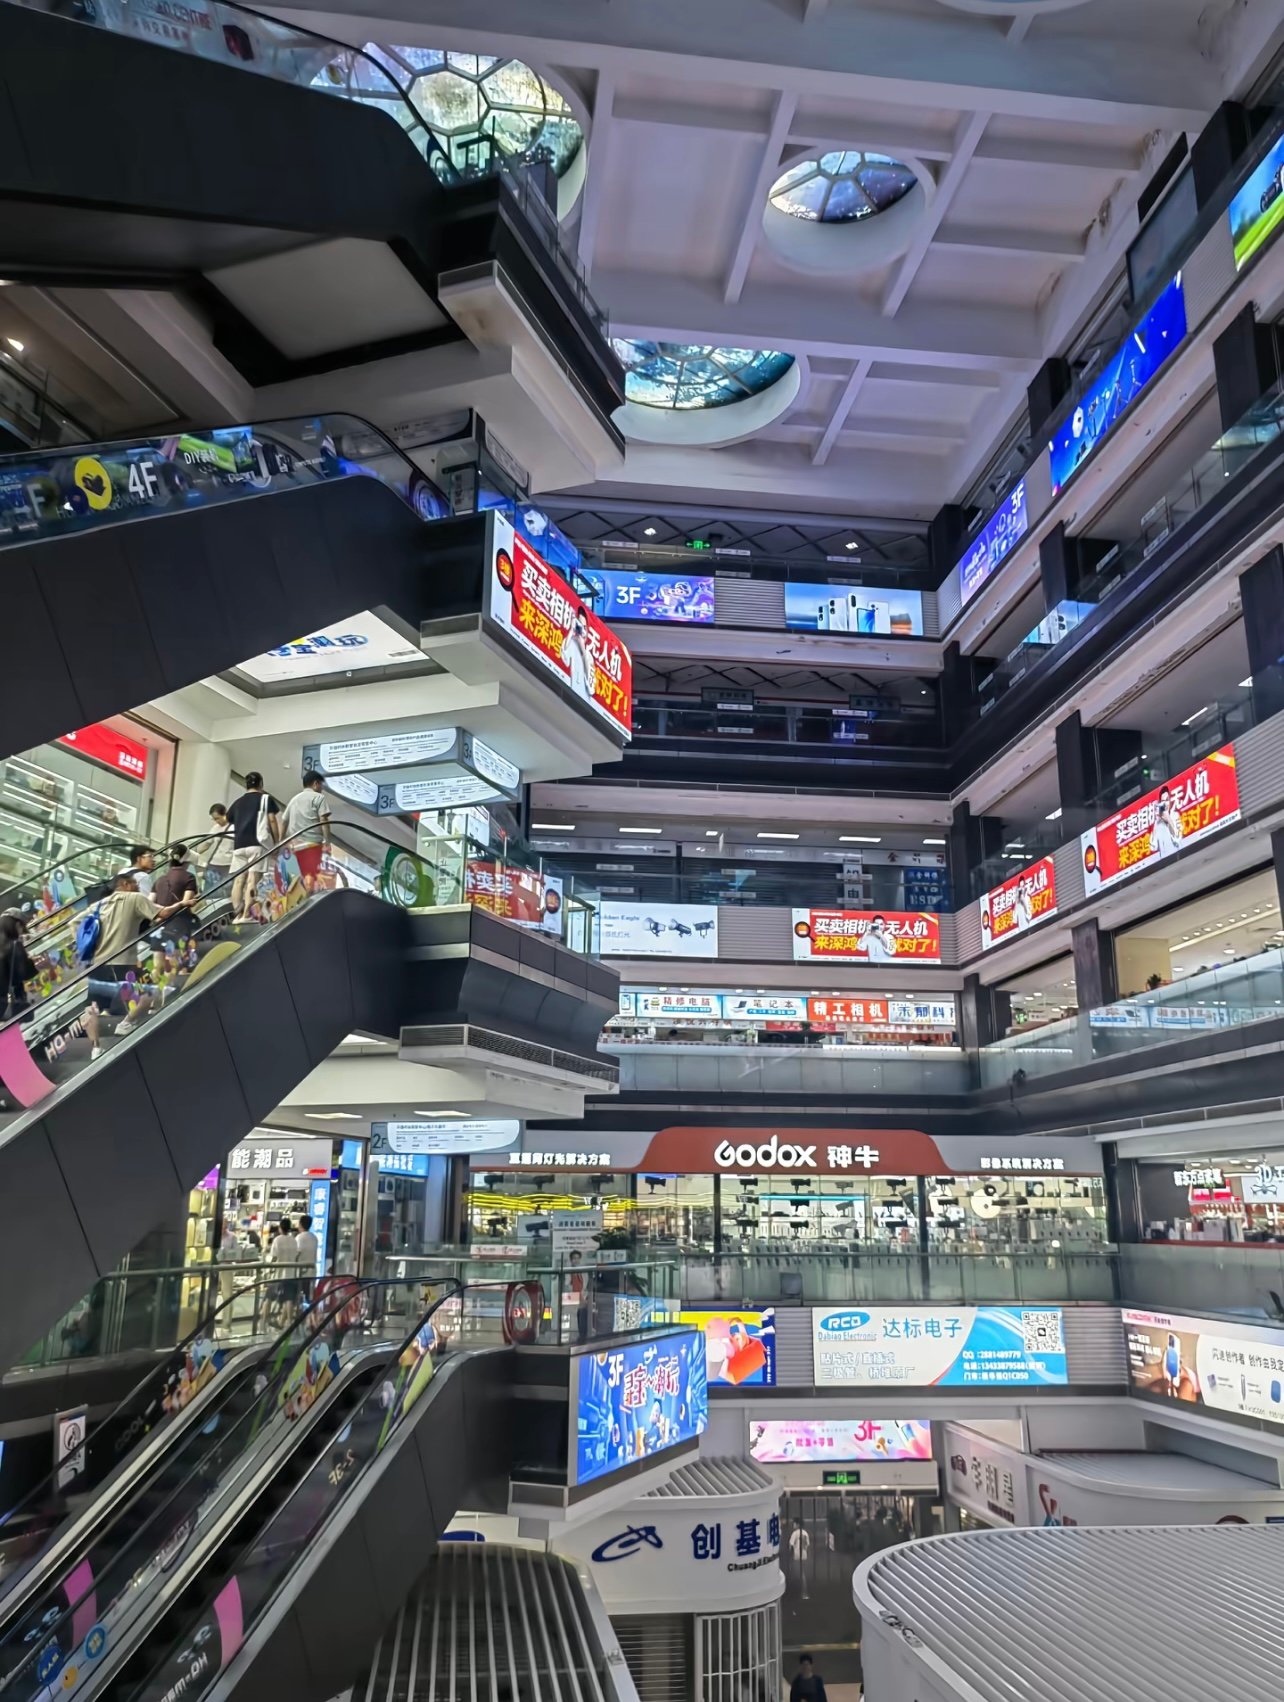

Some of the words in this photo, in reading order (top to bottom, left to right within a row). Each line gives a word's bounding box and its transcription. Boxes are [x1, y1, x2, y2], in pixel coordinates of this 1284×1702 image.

[128, 461, 157, 499] 4F
[1011, 482, 1025, 514] 3F
[521, 560, 577, 632] 买卖相机
[616, 586, 641, 604] 3F
[585, 626, 622, 682] 无人机
[1170, 768, 1209, 813] 无人机
[814, 918, 871, 935] 买卖相机
[886, 919, 928, 936] 无人机
[663, 997, 711, 1006] 精修电脑
[754, 1000, 793, 1008] 笔记本
[814, 1001, 883, 1018] 精工相机
[372, 1133, 387, 1149] 2F
[714, 1134, 817, 1167] Godox
[827, 1145, 879, 1168] 神牛
[231, 1148, 295, 1169] 能潮品
[818, 1332, 842, 1341] Dabiao
[843, 1332, 878, 1341] Electronic
[882, 1317, 963, 1339] 达标电子
[962, 1351, 974, 1359] QQ
[608, 1353, 625, 1388] 3F
[854, 1419, 882, 1441] 3F
